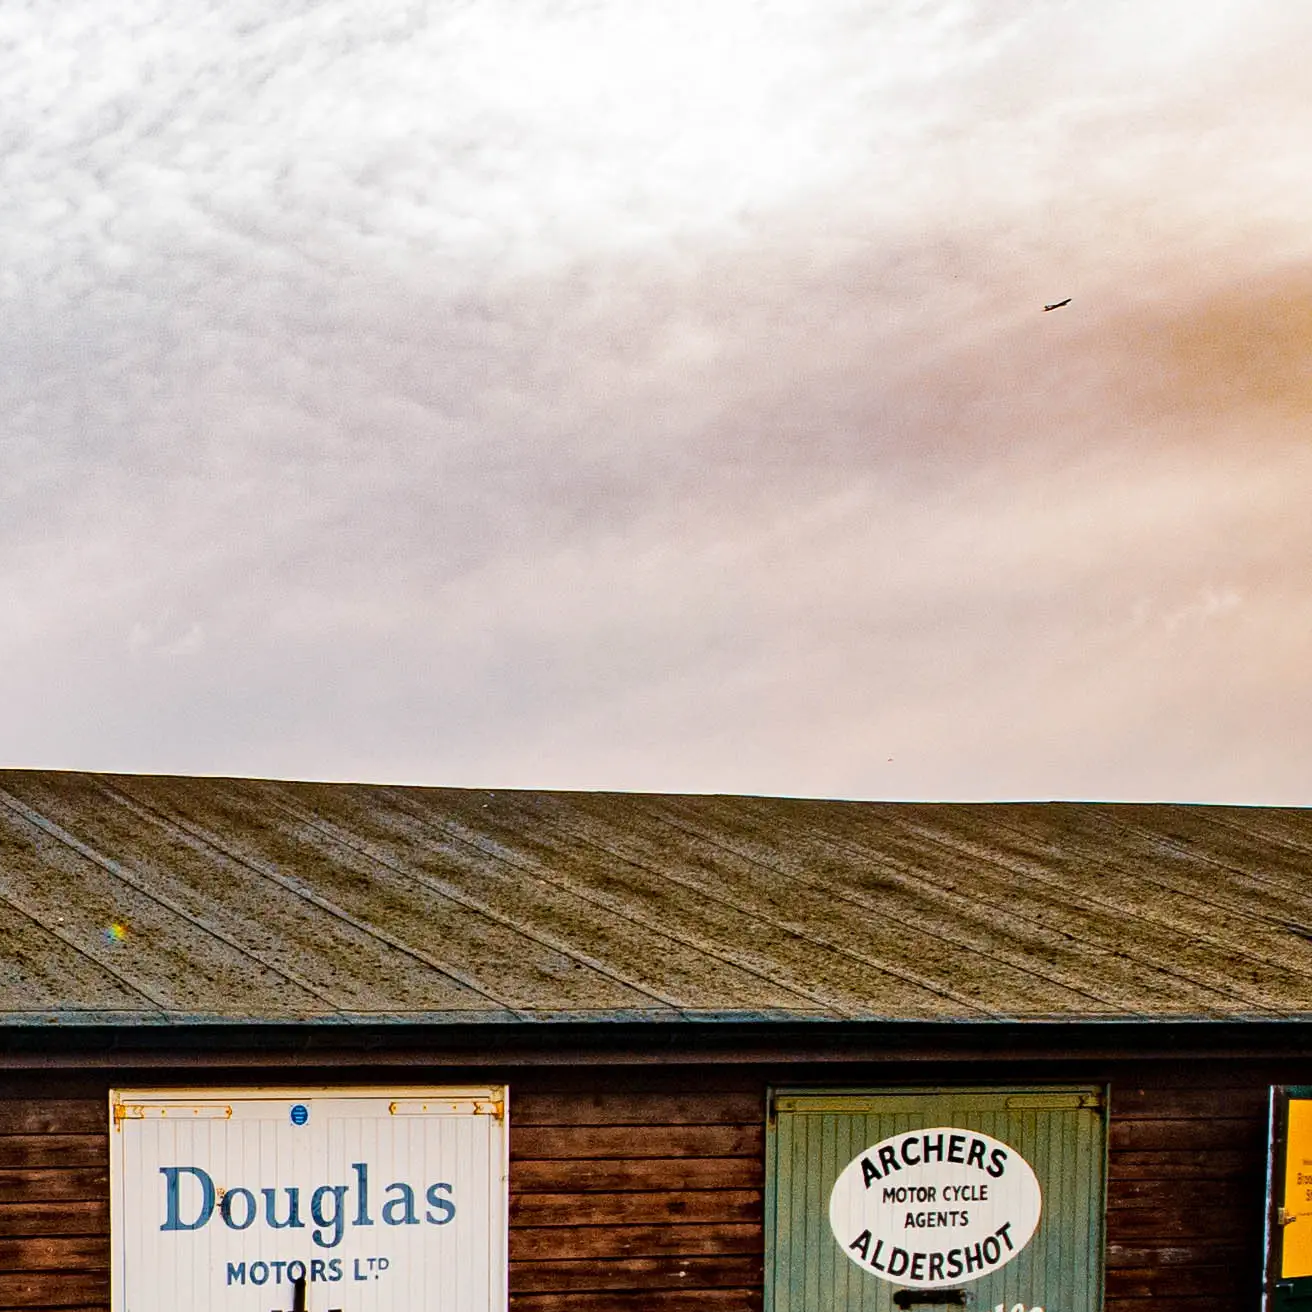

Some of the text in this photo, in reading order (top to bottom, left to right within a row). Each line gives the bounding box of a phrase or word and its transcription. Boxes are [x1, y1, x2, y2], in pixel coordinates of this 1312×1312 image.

[860, 1134, 1008, 1190] ARCHERS
[159, 1162, 456, 1249] Douglas
[882, 1184, 989, 1204] MOTOR CYCLE
[903, 1210, 969, 1229] AGENTS
[227, 1258, 343, 1286] MOTORS
[848, 1222, 1015, 1281] ALDERSHOT
